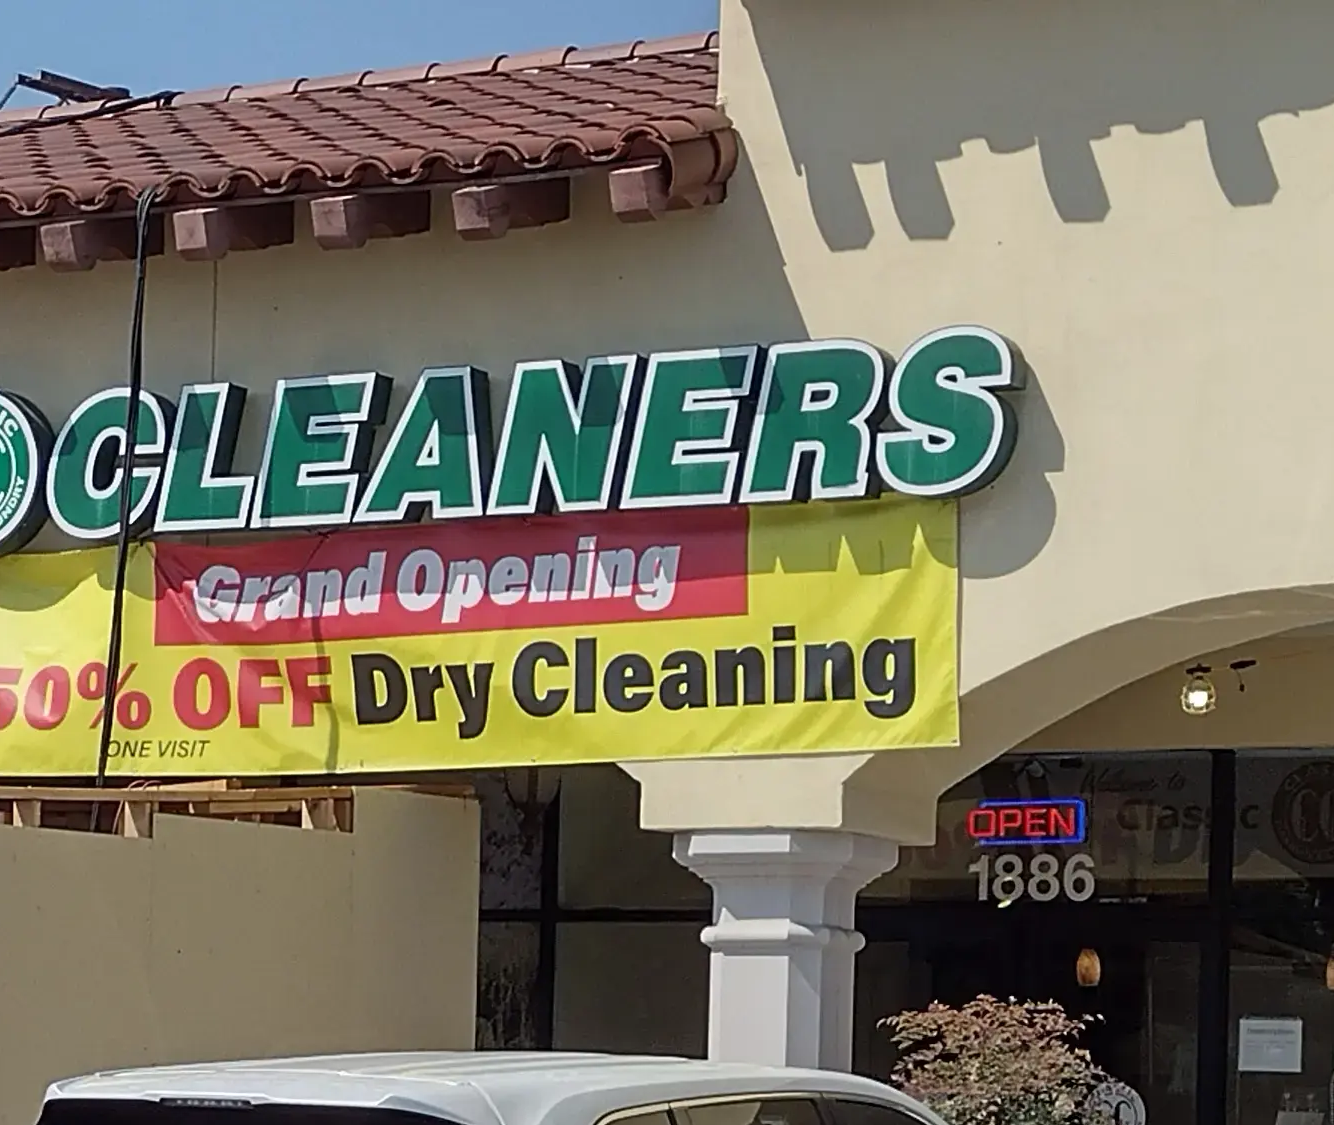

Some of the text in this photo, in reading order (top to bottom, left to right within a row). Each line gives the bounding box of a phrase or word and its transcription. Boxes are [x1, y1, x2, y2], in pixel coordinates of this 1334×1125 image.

[46, 324, 1019, 541] CLEANERS
[193, 534, 680, 625] Grand Opening
[172, 654, 334, 732] OFF
[351, 650, 495, 740] Dry
[511, 623, 918, 720] Cleaning
[105, 739, 211, 758] ONE VISIT
[967, 807, 1077, 840] OPEN
[967, 853, 1096, 902] 1886
